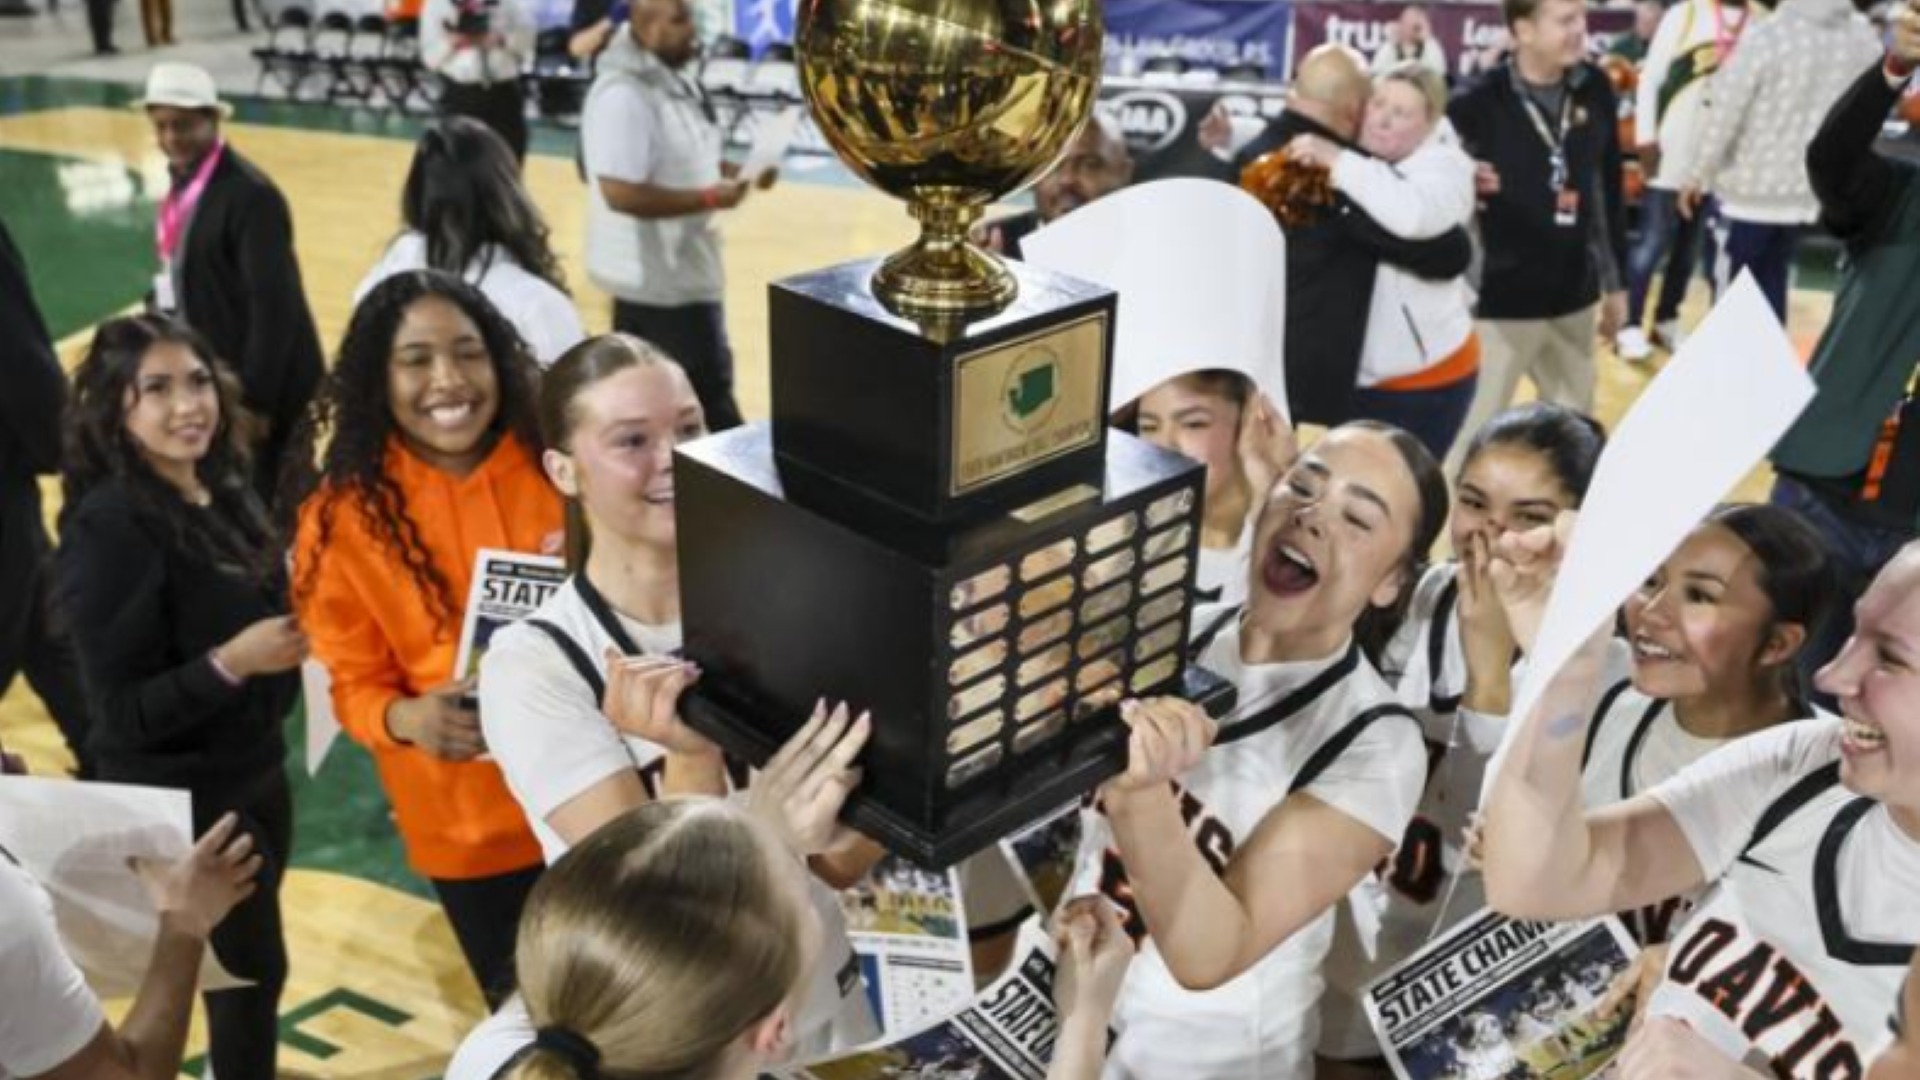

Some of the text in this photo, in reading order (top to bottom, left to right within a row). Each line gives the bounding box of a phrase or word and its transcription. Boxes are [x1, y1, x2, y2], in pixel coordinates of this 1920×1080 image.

[979, 976, 1057, 1042] STATE
[1378, 960, 1463, 1030] STATE
[1460, 917, 1556, 977] CHAM
